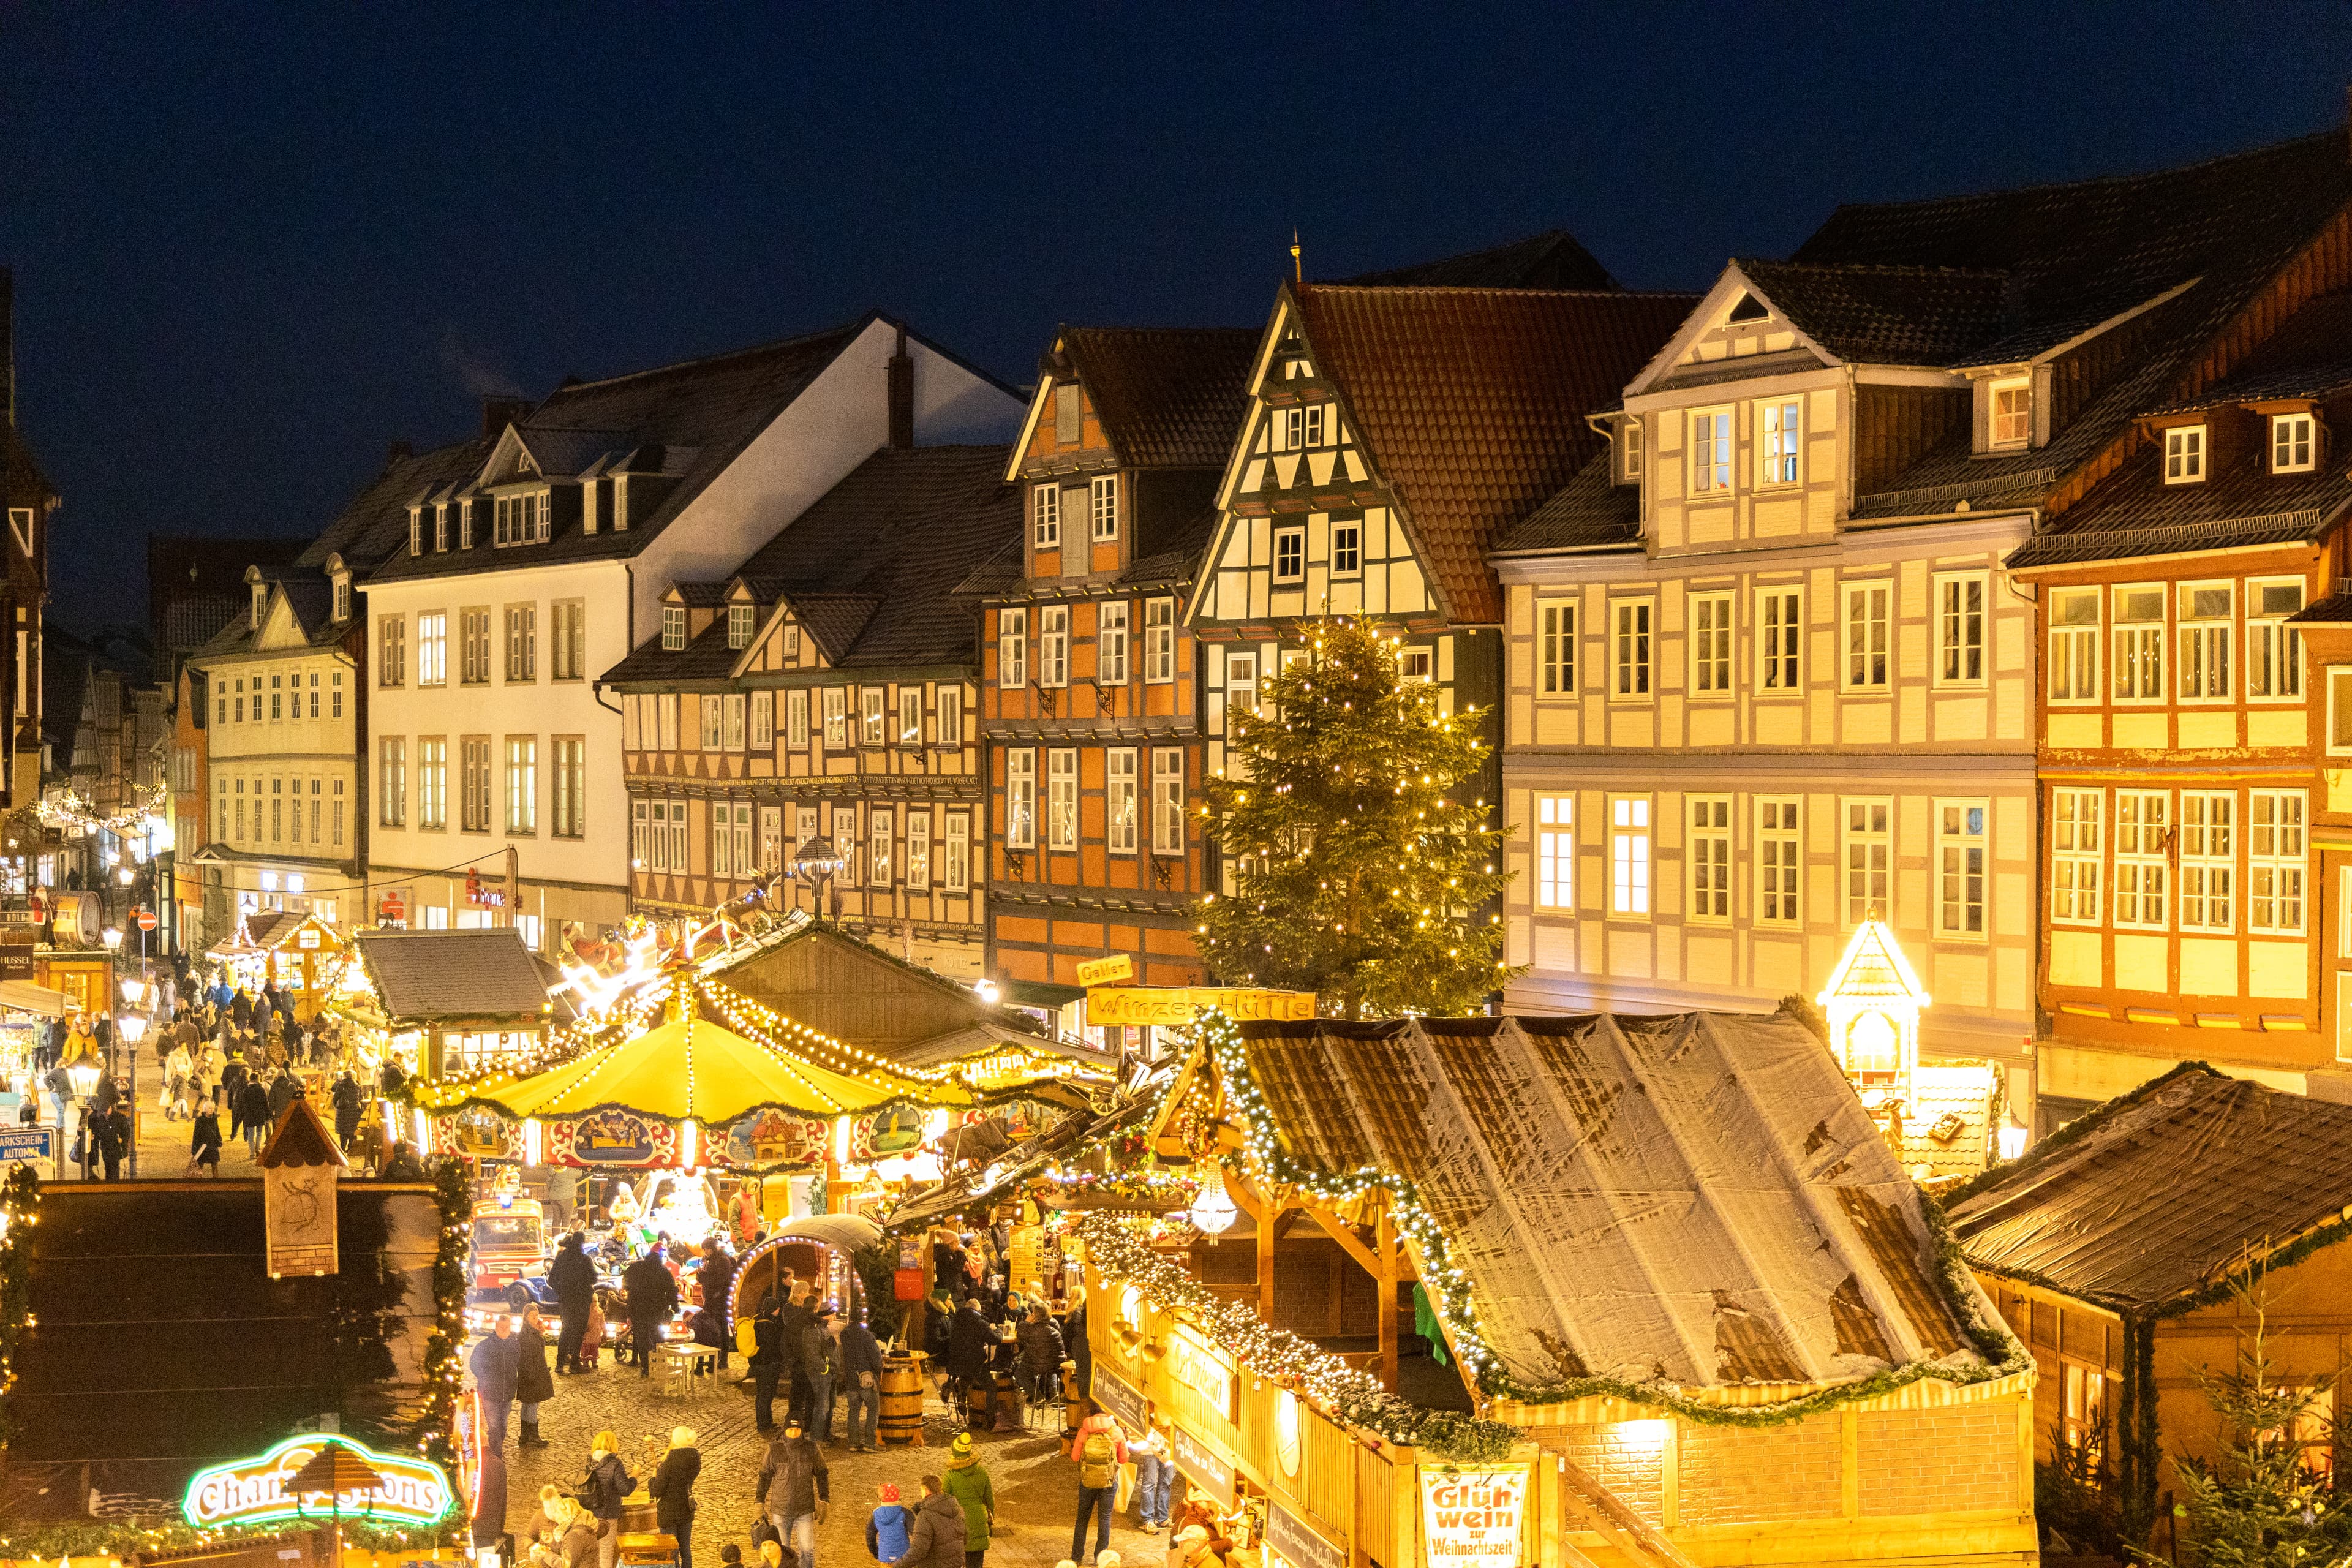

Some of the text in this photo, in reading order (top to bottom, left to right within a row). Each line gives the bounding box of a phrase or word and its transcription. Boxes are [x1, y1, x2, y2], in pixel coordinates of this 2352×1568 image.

[1090, 993, 1205, 1018] Winzer
[0, 1135, 48, 1147] ARKSCHEIN-
[1435, 1504, 1513, 1528] wein
[1469, 1530, 1487, 1539] zur
[1432, 1537, 1513, 1556] Weihnachtszeit
